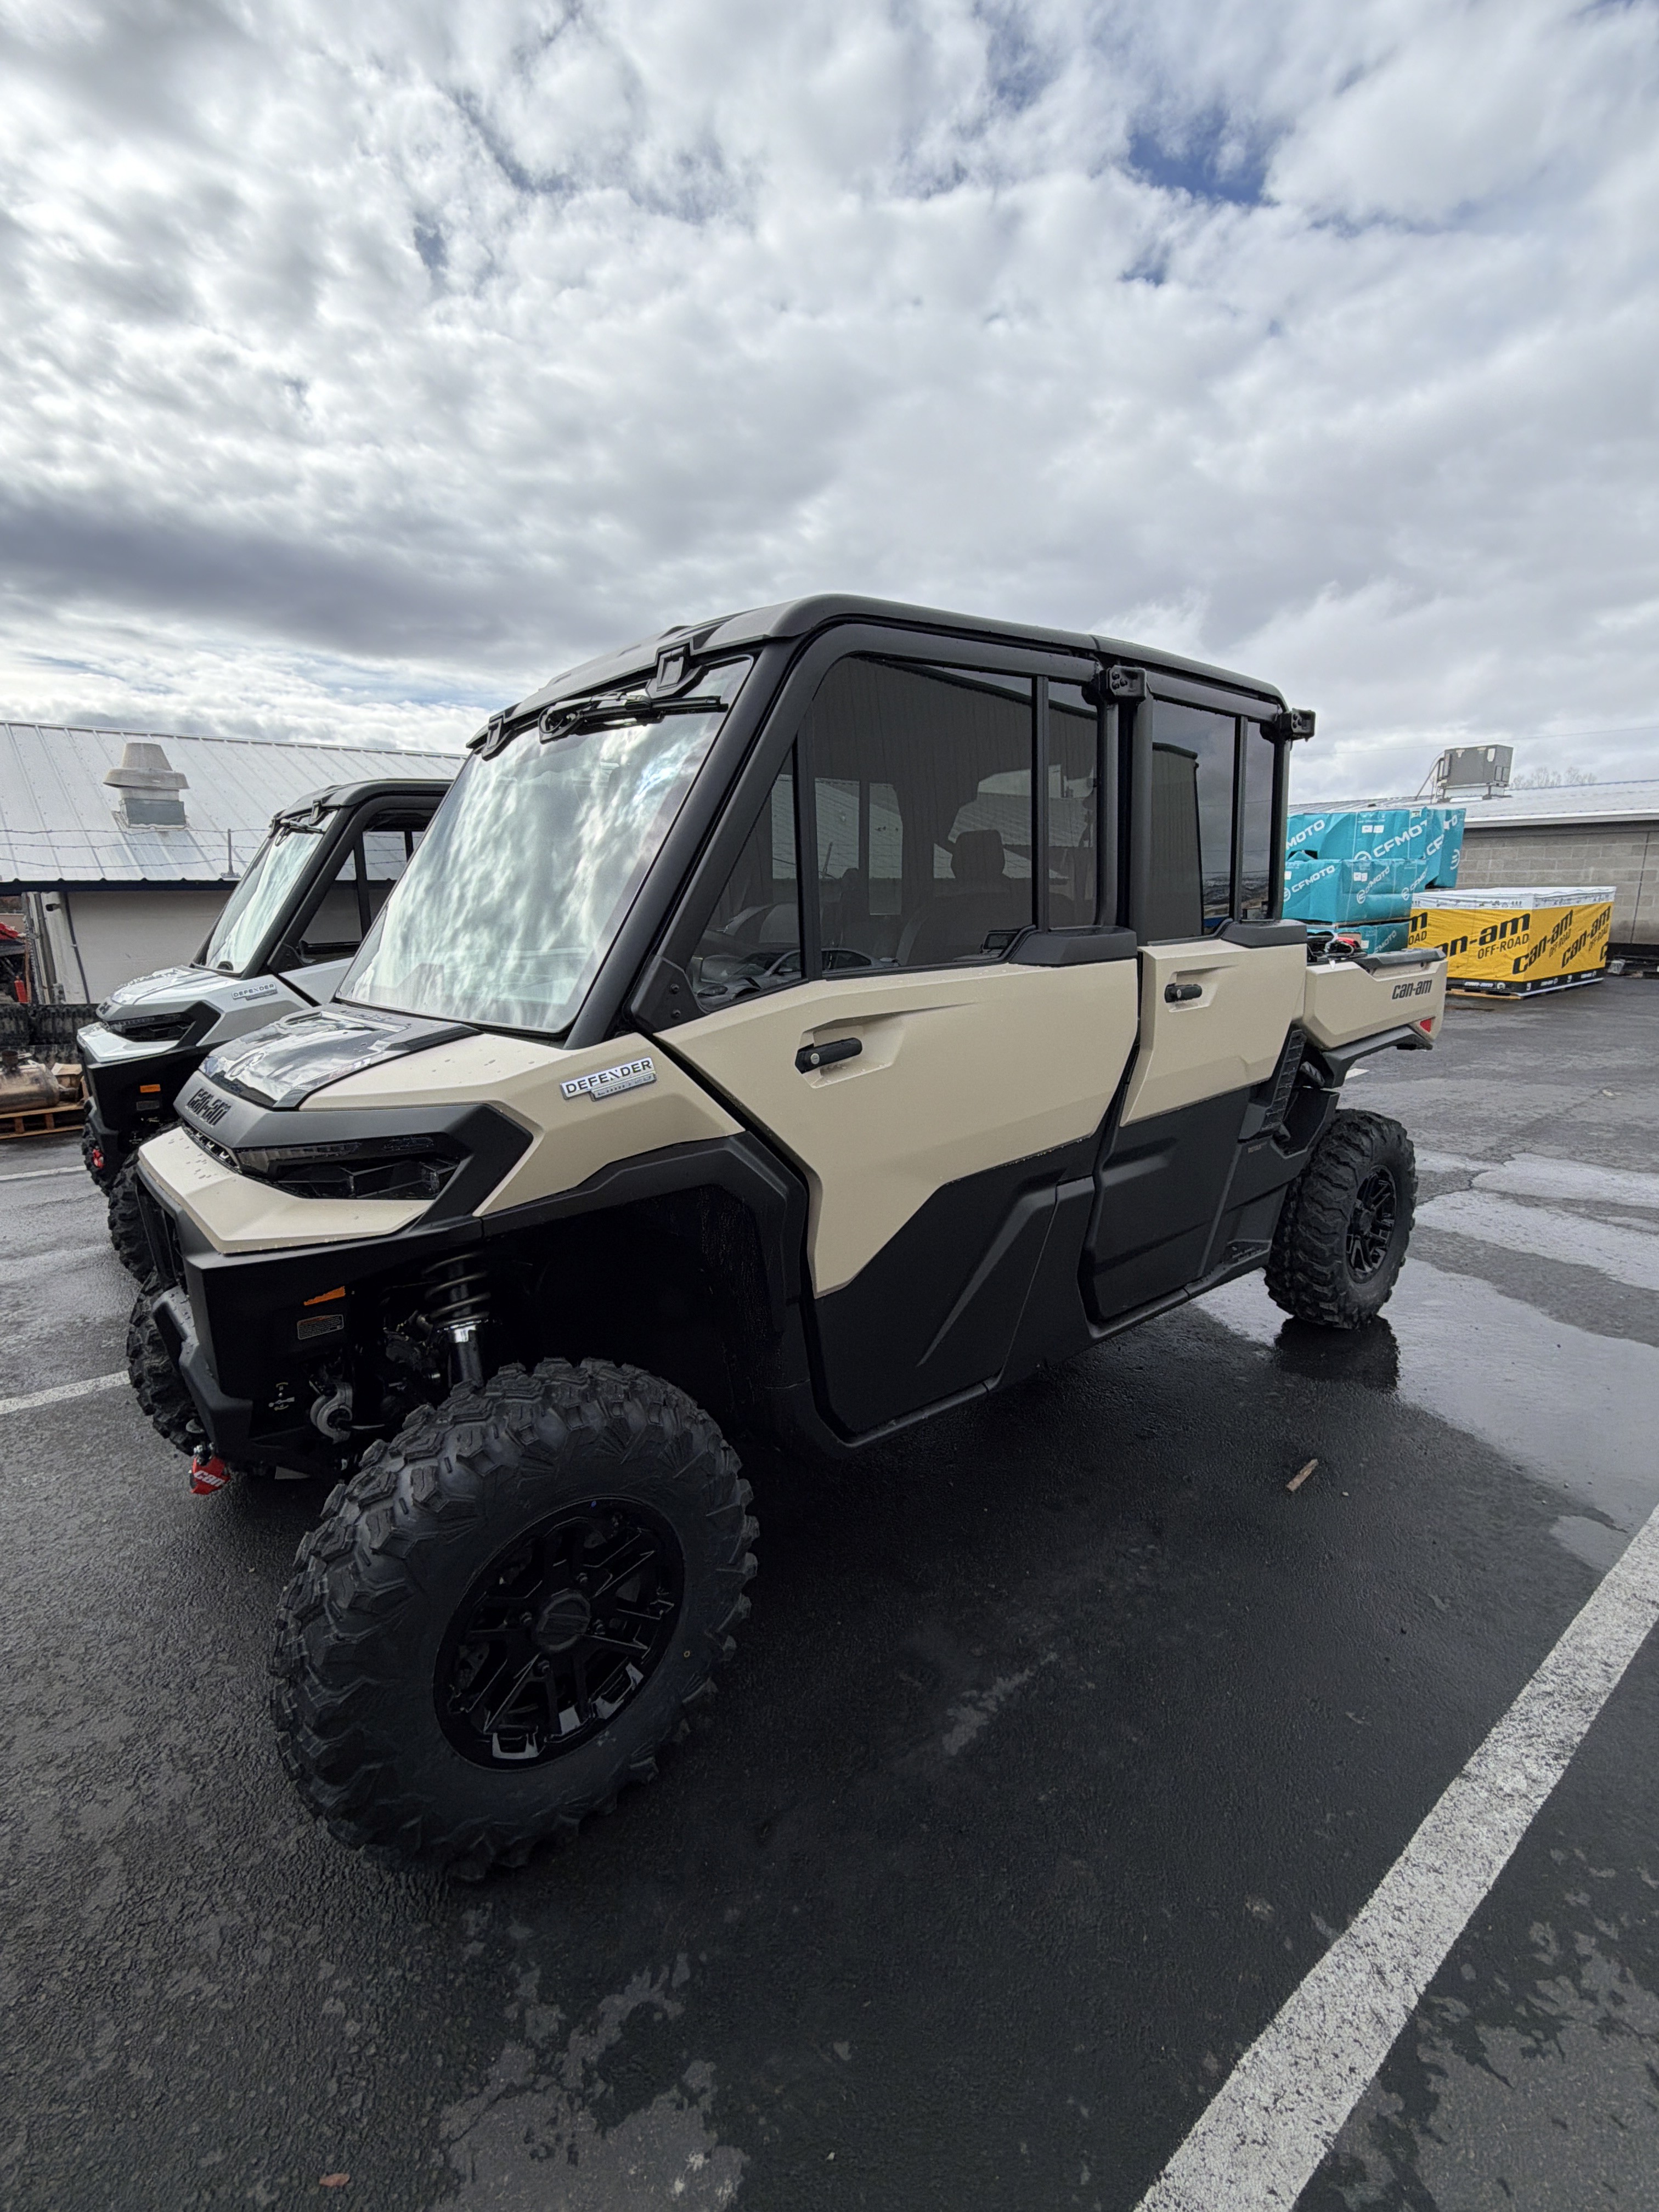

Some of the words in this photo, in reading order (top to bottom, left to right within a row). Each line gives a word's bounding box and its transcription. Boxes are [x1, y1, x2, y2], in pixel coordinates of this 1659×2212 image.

[1291, 865, 1335, 893] CFMOTO
[1477, 933, 1530, 960] OFF-ROAD
[1512, 909, 1573, 975] can-am
[1561, 905, 1611, 969] can-am
[233, 984, 274, 997] DEFENDER
[1392, 979, 1432, 1000] can-am
[565, 1059, 652, 1094] DEFENDER
[187, 1088, 232, 1126] can-am
